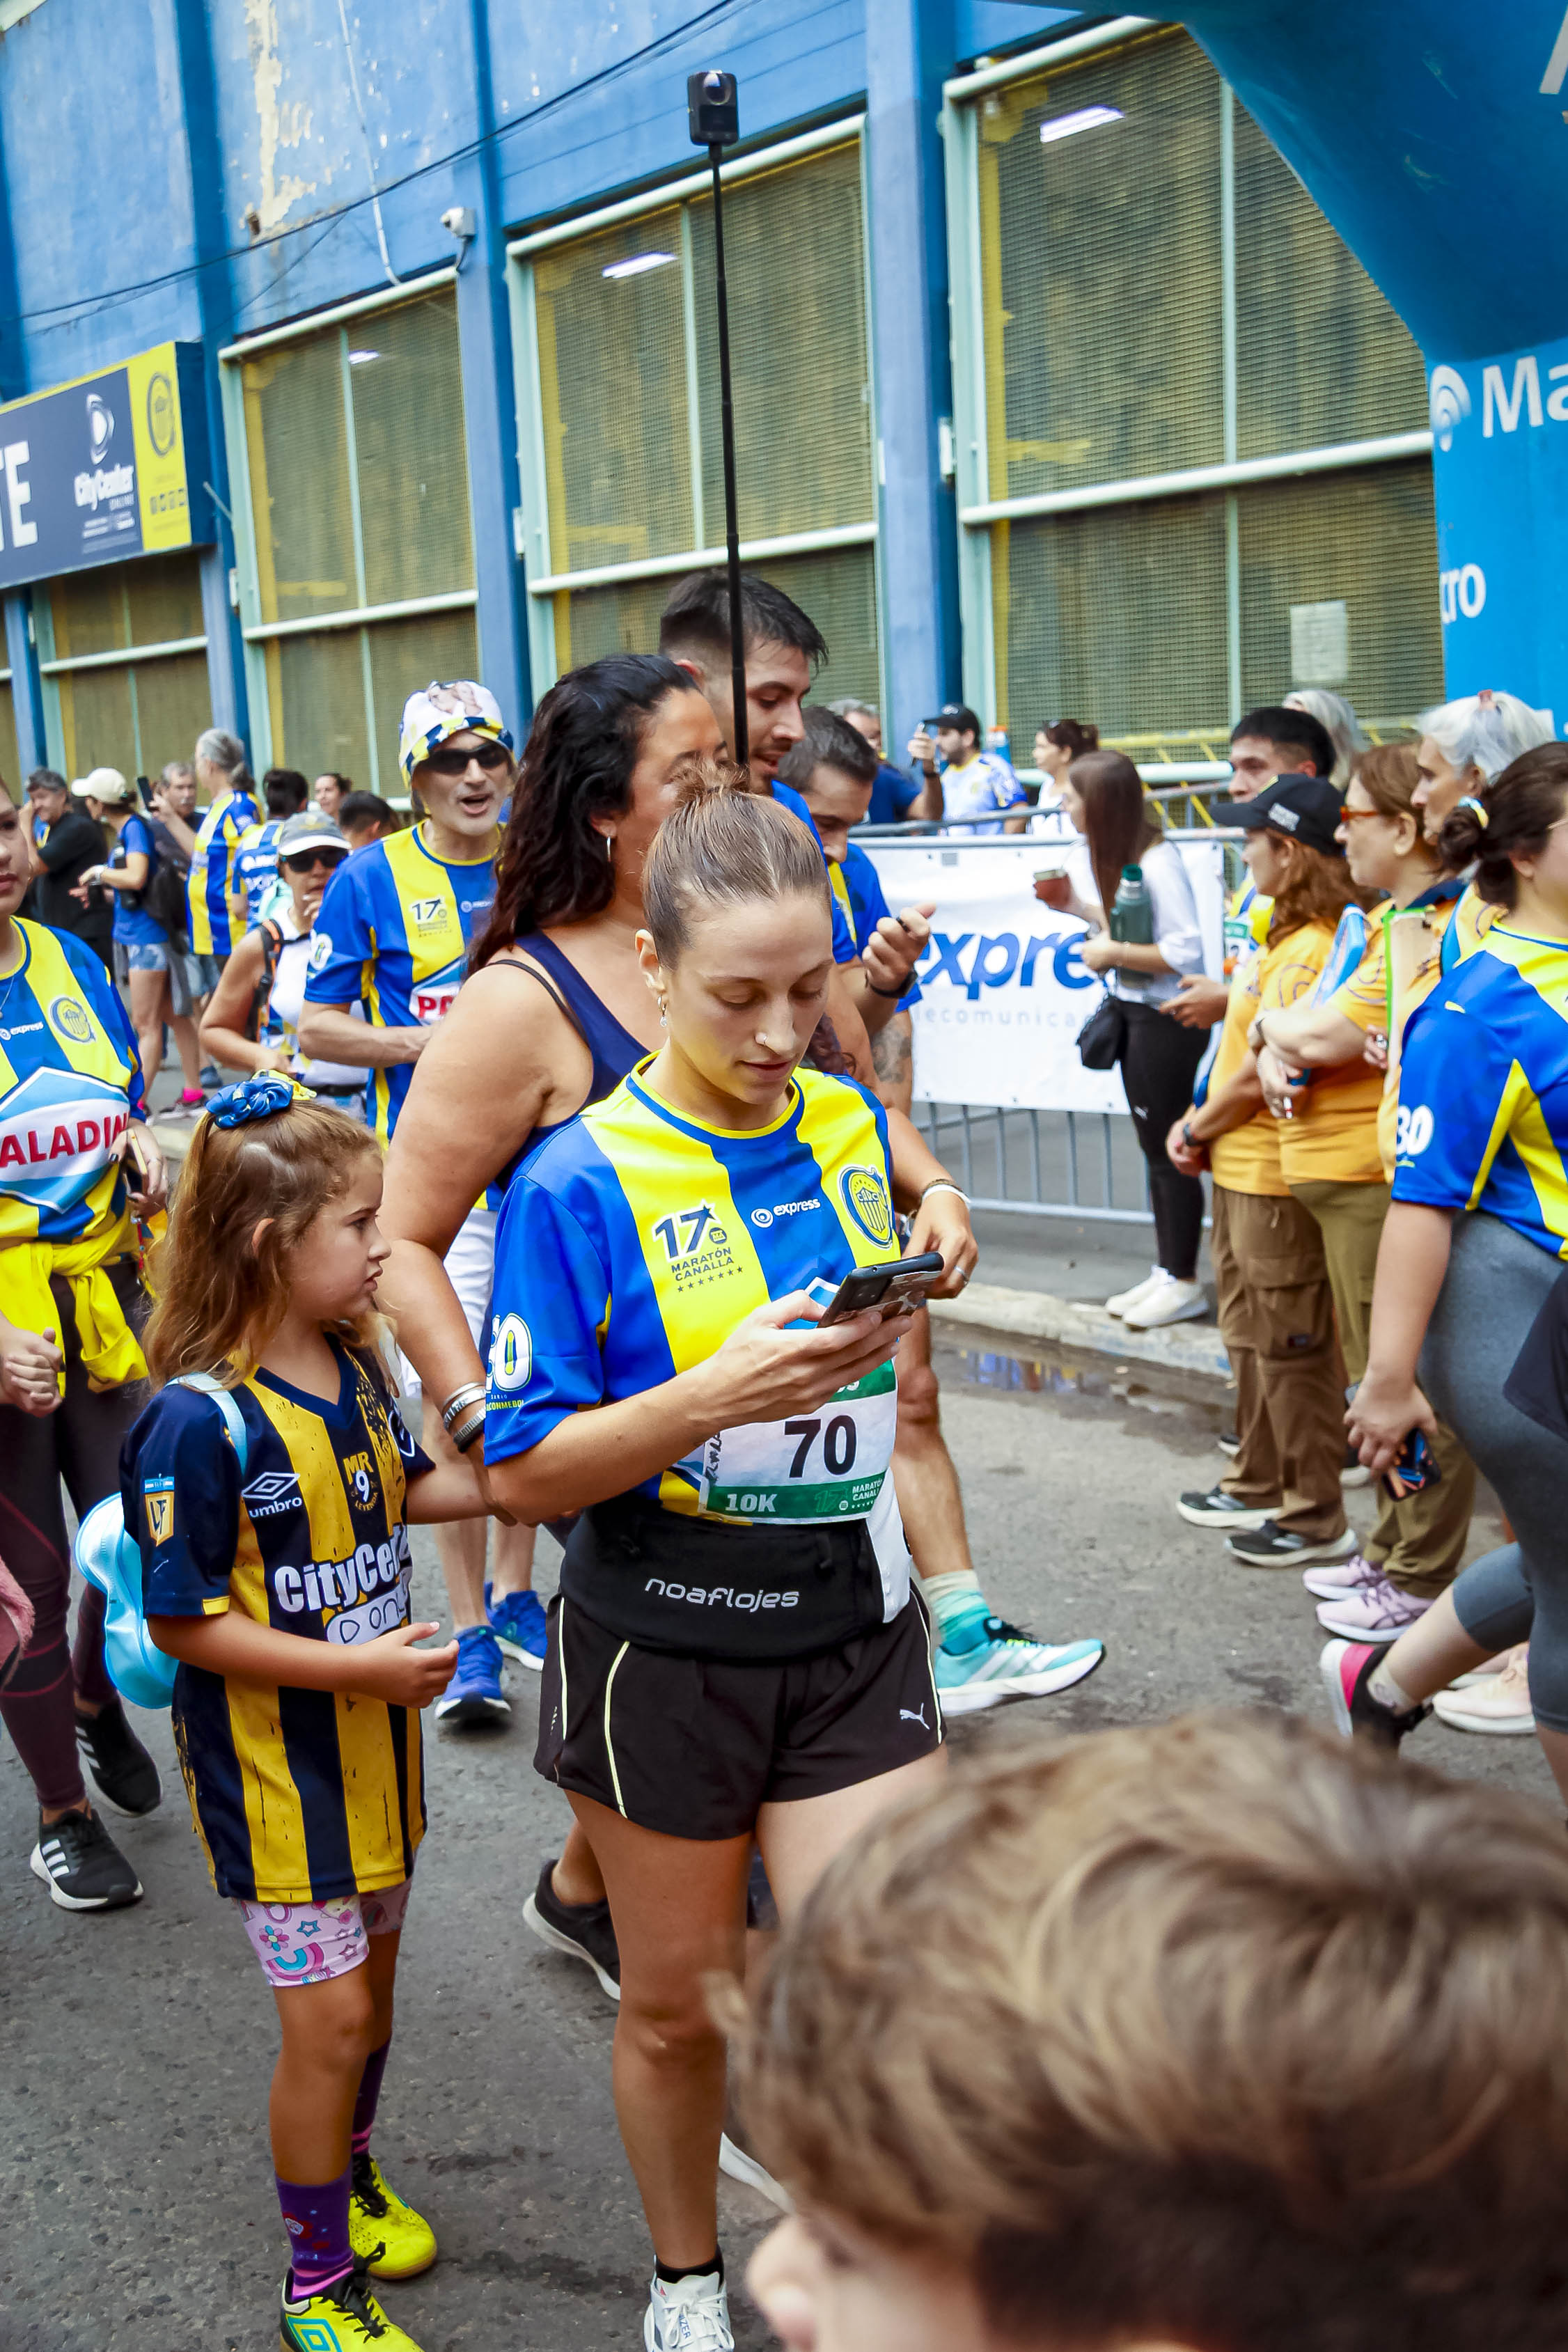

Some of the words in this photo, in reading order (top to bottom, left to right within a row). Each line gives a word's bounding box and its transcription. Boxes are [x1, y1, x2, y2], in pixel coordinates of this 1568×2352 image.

[0, 440, 38, 551] E
[411, 898, 441, 920] 17
[918, 932, 1095, 1001] xpre
[10, 1021, 44, 1035] express
[773, 1198, 821, 1216] express
[654, 1205, 715, 1259] 17
[671, 1247, 732, 1273] MARATÓN
[675, 1256, 735, 1282] CANALLA
[784, 1415, 857, 1478] 70
[343, 1451, 374, 1485] MR
[355, 1469, 370, 1503] 9
[249, 1496, 302, 1519] umbro
[725, 1493, 778, 1512] 10K
[645, 1578, 799, 1613] noaflojes
